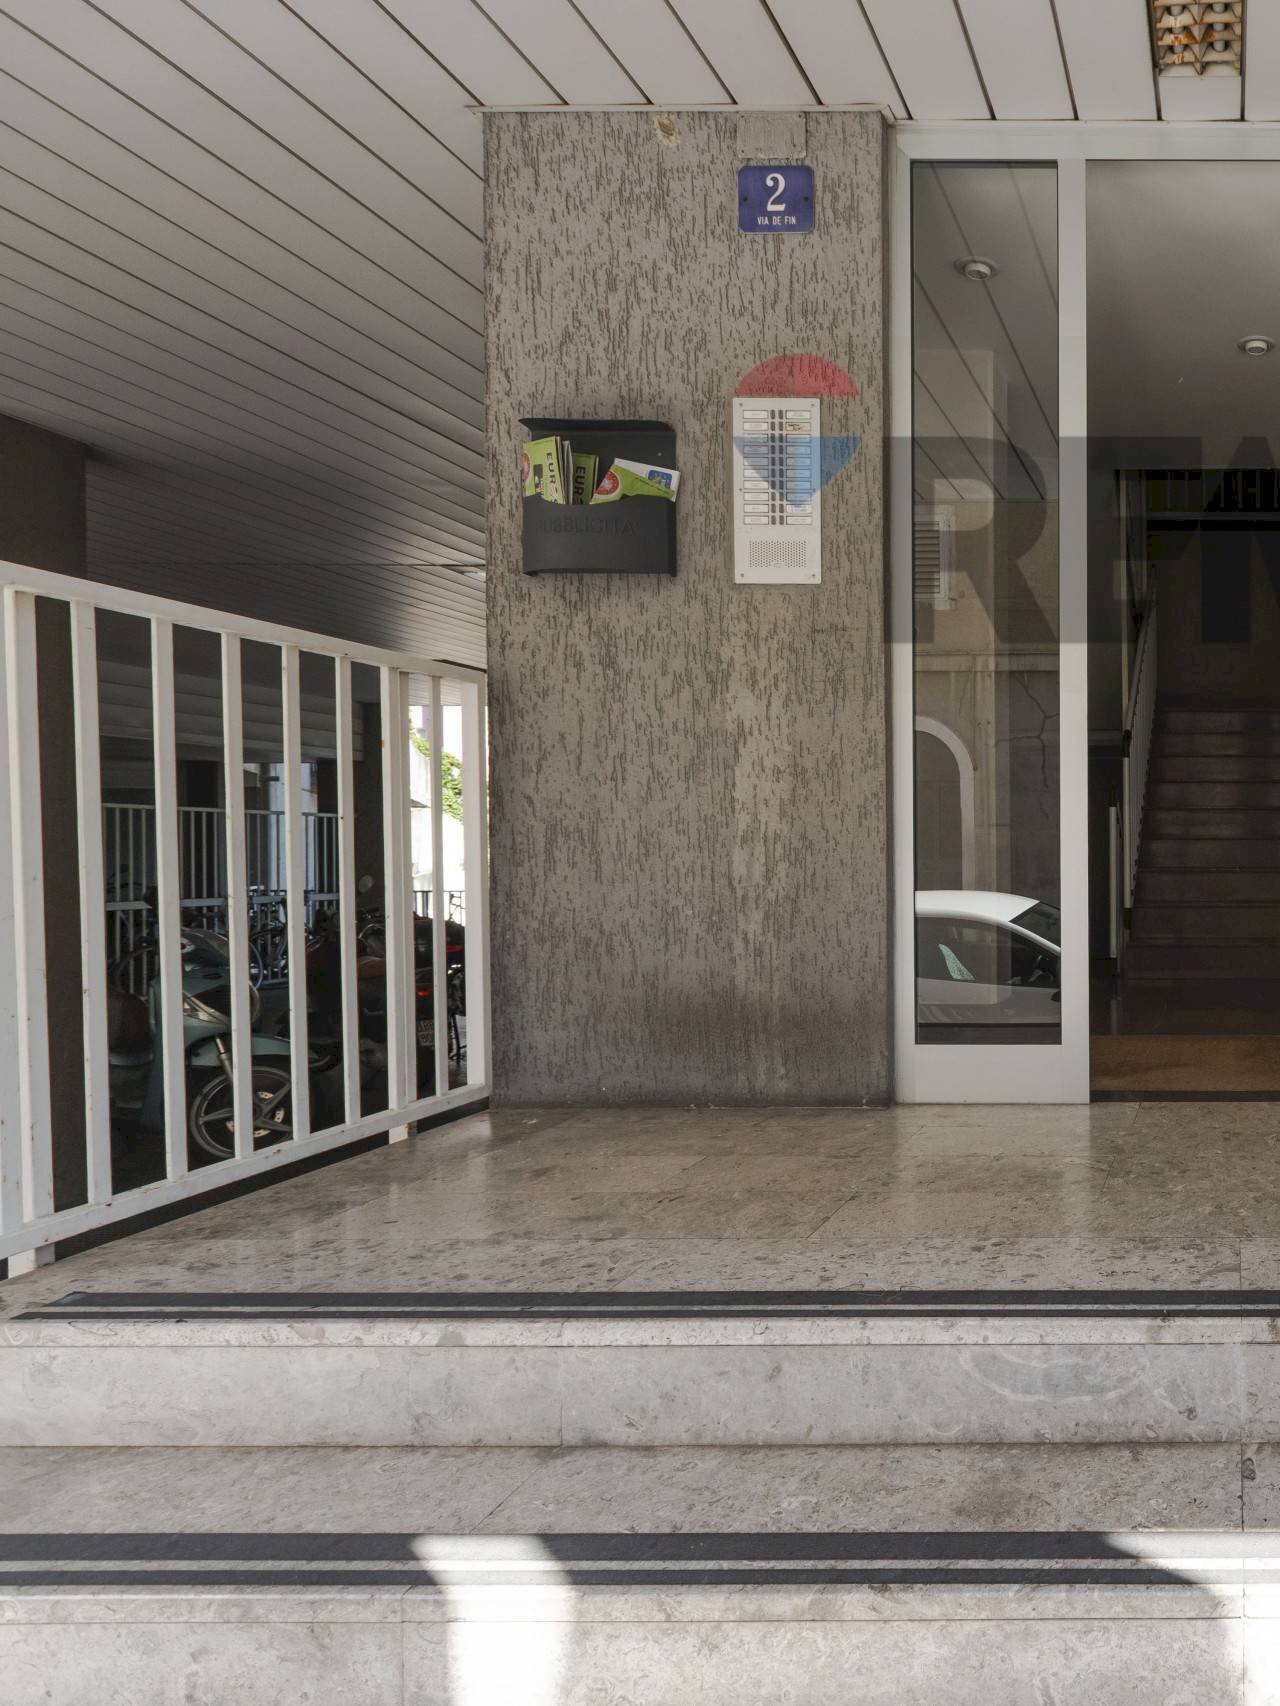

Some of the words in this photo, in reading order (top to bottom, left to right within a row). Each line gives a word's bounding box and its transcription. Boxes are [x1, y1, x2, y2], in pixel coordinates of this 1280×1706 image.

[766, 173, 786, 211] 2
[757, 216, 769, 225] VIA
[772, 216, 782, 225] DE
[784, 216, 796, 225] FIN
[574, 466, 586, 504] EUR
